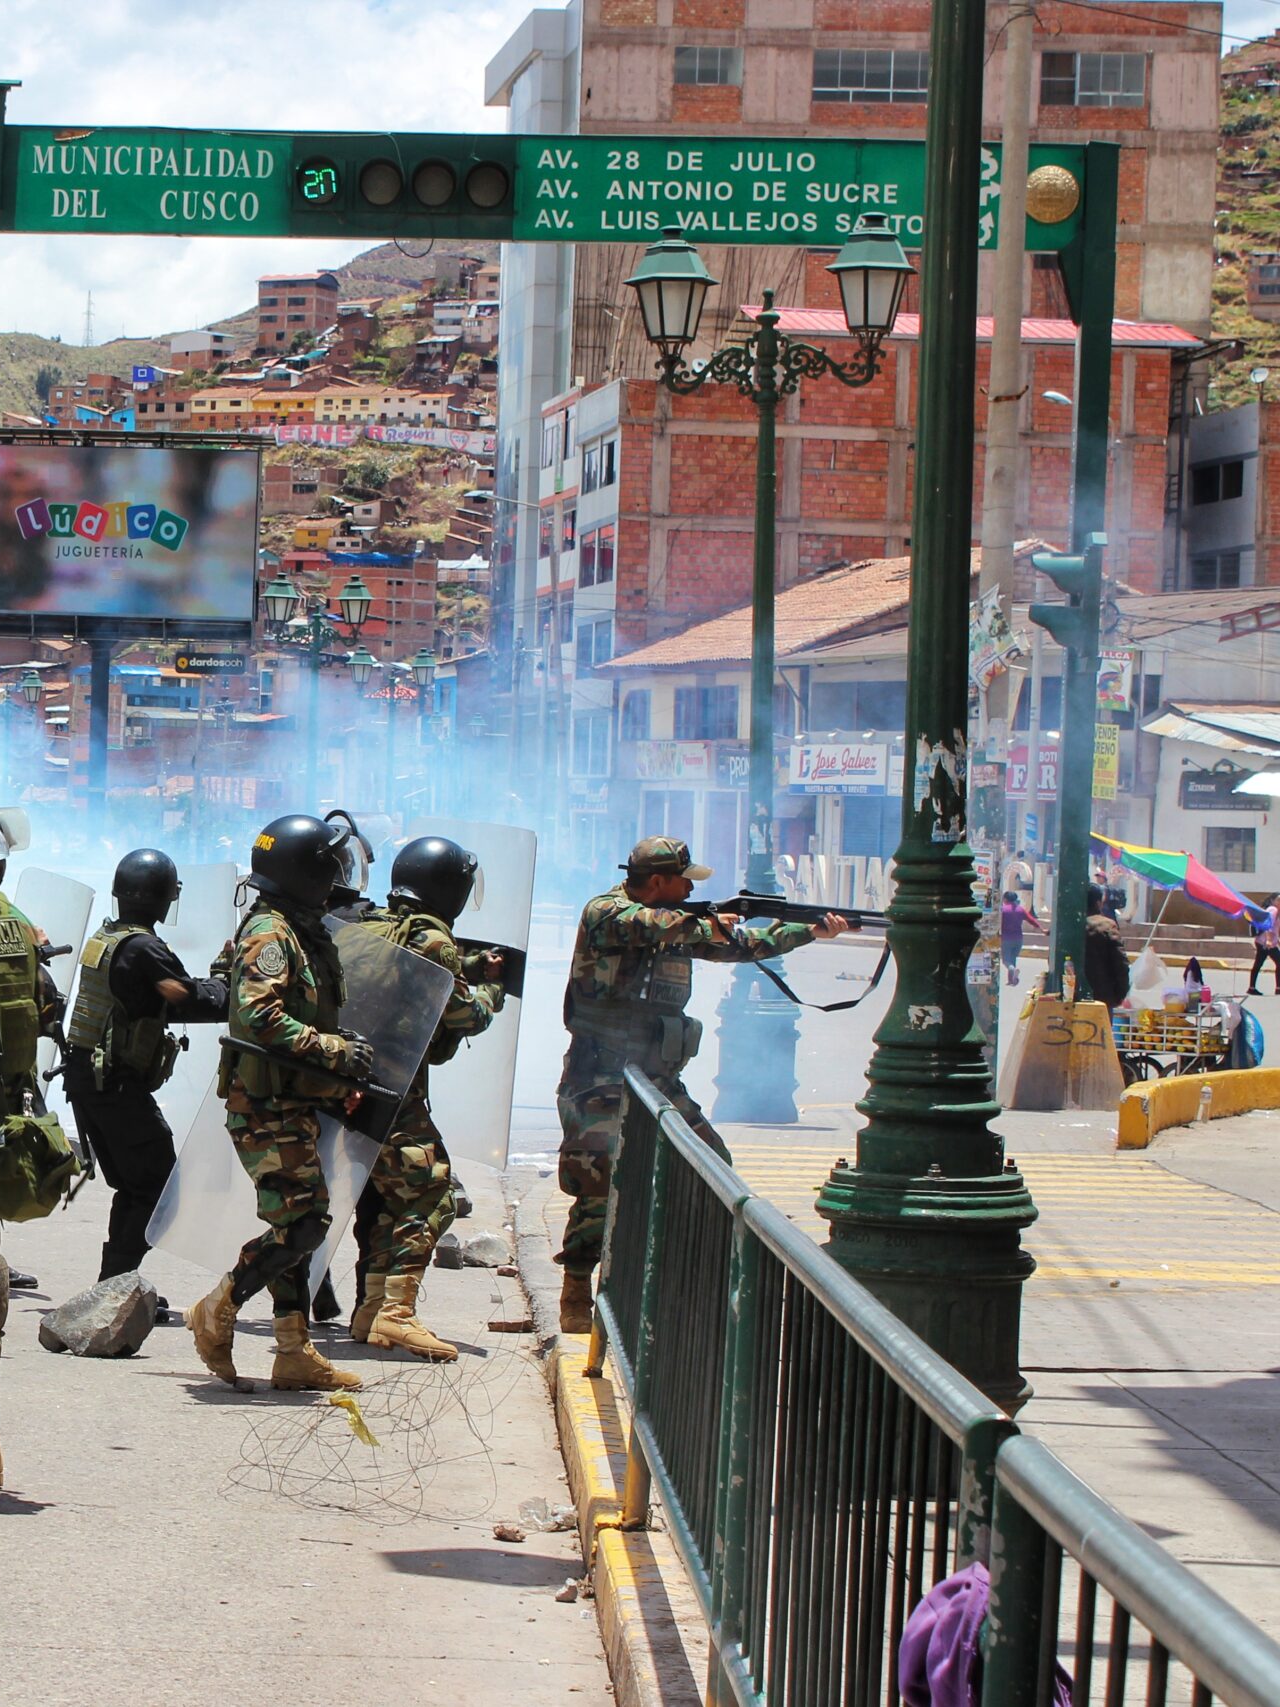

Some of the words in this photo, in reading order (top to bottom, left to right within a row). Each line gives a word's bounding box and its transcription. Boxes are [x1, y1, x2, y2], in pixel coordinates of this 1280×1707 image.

[32, 145, 275, 179] MUNICIPALIDAD
[537, 149, 579, 169] AV.
[606, 151, 640, 170] 28
[666, 151, 704, 171] DE
[729, 151, 816, 173] JULIO
[51, 188, 107, 219] DEL
[159, 190, 260, 222] CUSCO
[536, 178, 579, 200] AV.
[606, 180, 733, 202] ANTONIO
[752, 181, 787, 202] DE
[806, 183, 898, 205] SUCRE
[534, 208, 574, 229] AV.
[600, 210, 660, 231] LUIS
[676, 210, 818, 233] VALLEJOS
[834, 213, 924, 235] SATO
[55, 544, 144, 559] JUGUETERÍA
[1095, 726, 1117, 740] ENDE
